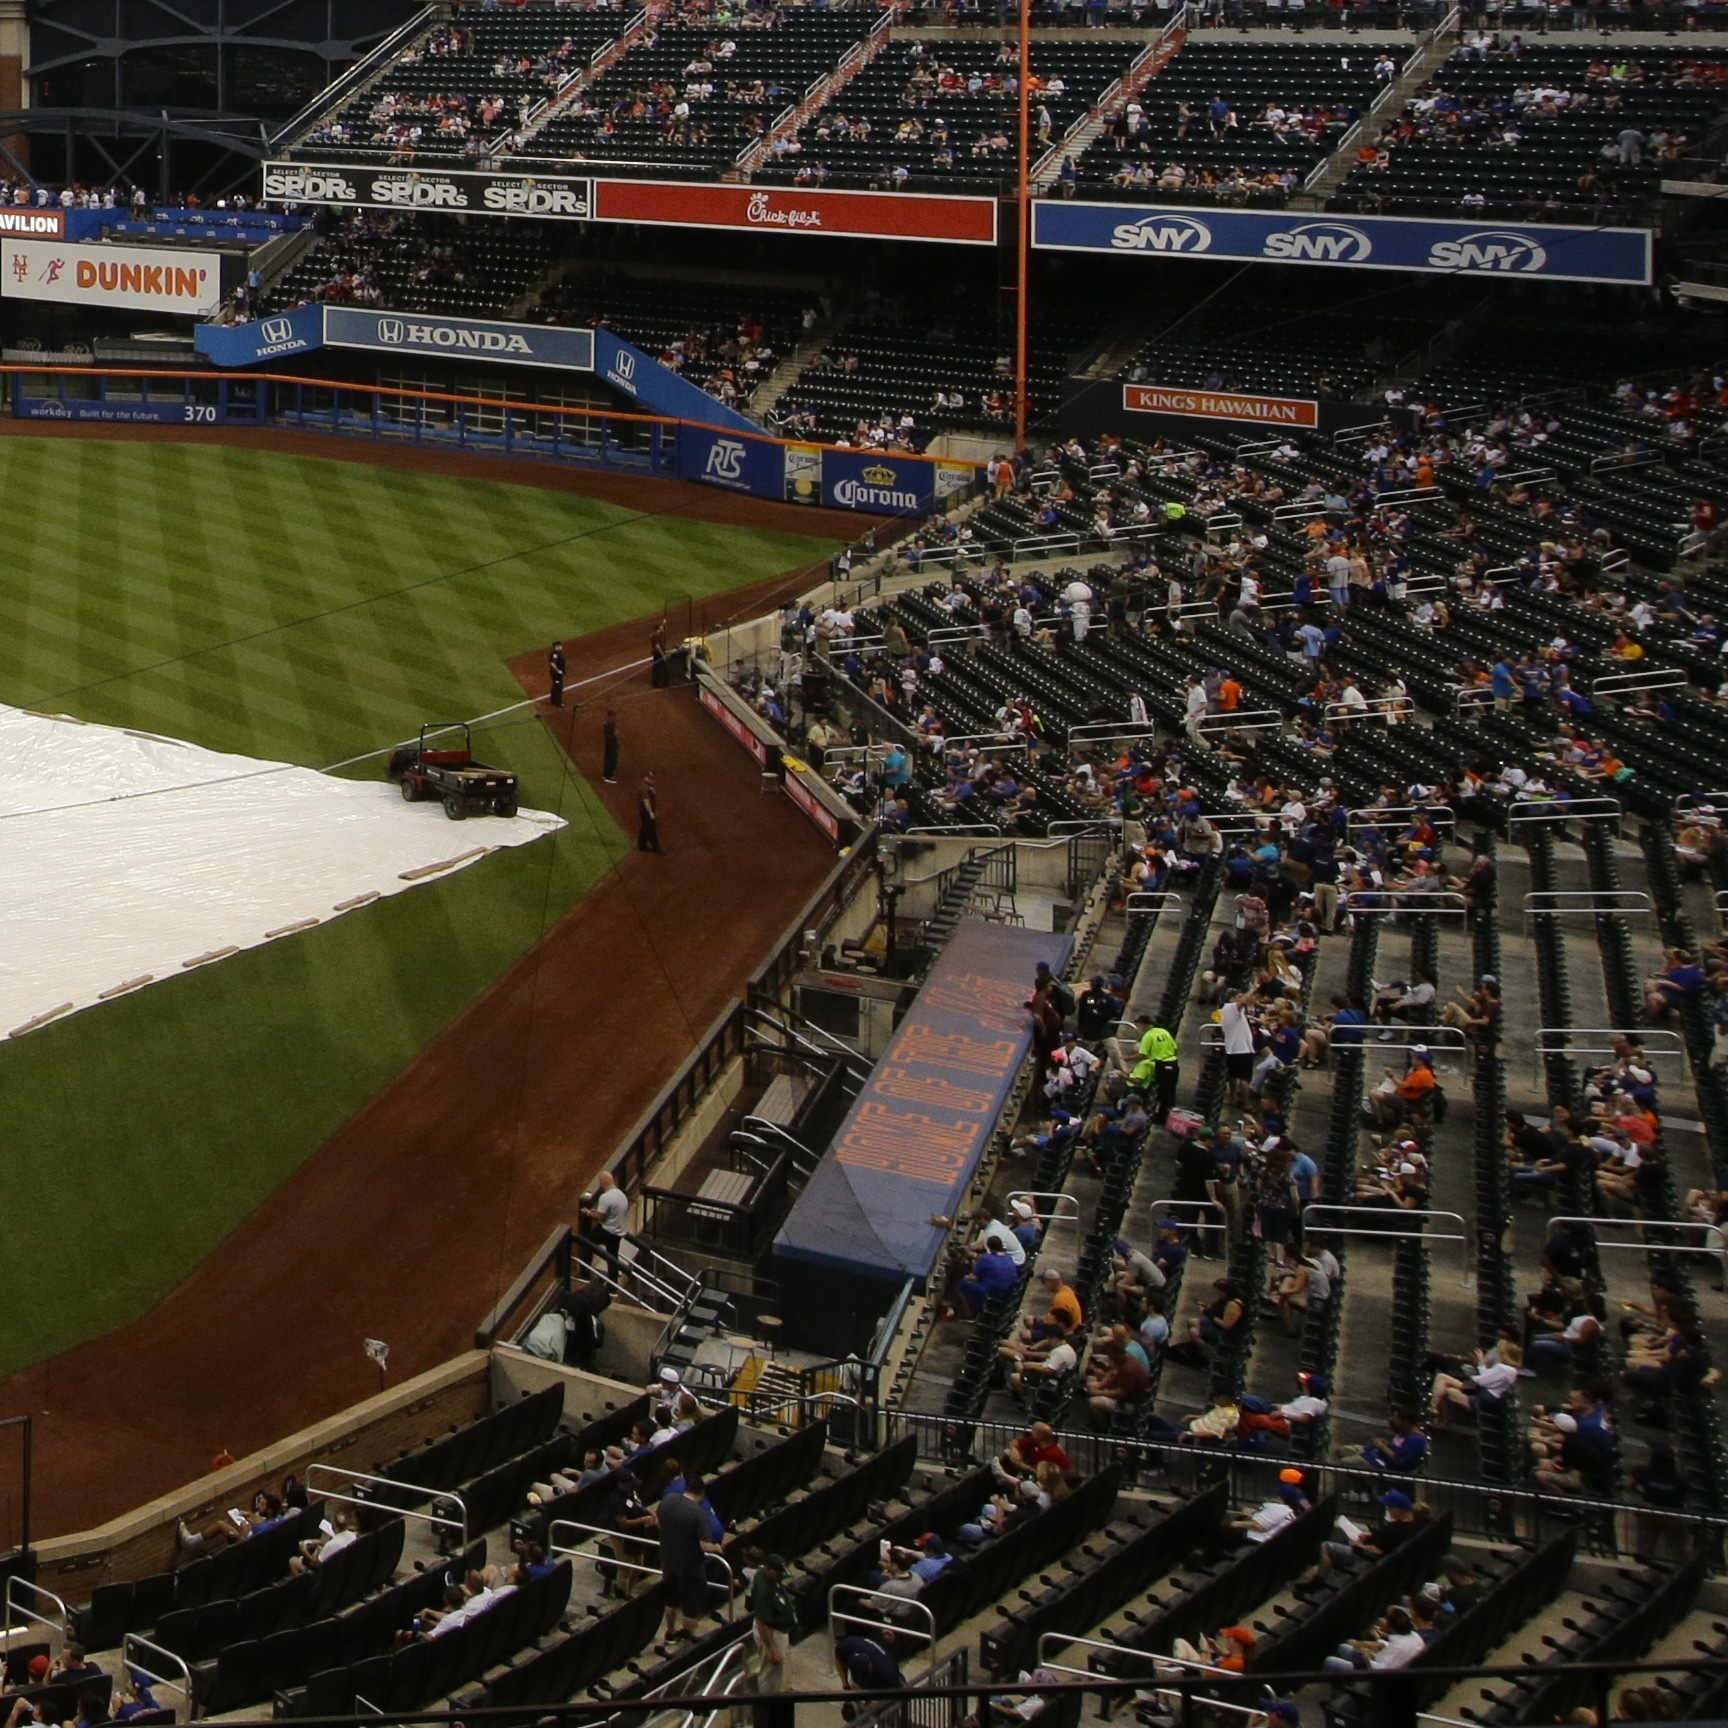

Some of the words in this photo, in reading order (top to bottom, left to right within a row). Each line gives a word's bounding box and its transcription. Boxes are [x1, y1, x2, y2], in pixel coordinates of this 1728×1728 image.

[1112, 225, 1196, 250] SNY
[76, 260, 206, 298] DUNKIN'
[406, 325, 533, 353] HONDA
[184, 406, 216, 422] 370
[1139, 392, 1196, 412] KING'S
[1201, 397, 1297, 421] HAWAIIAN
[834, 480, 916, 509] Corona
